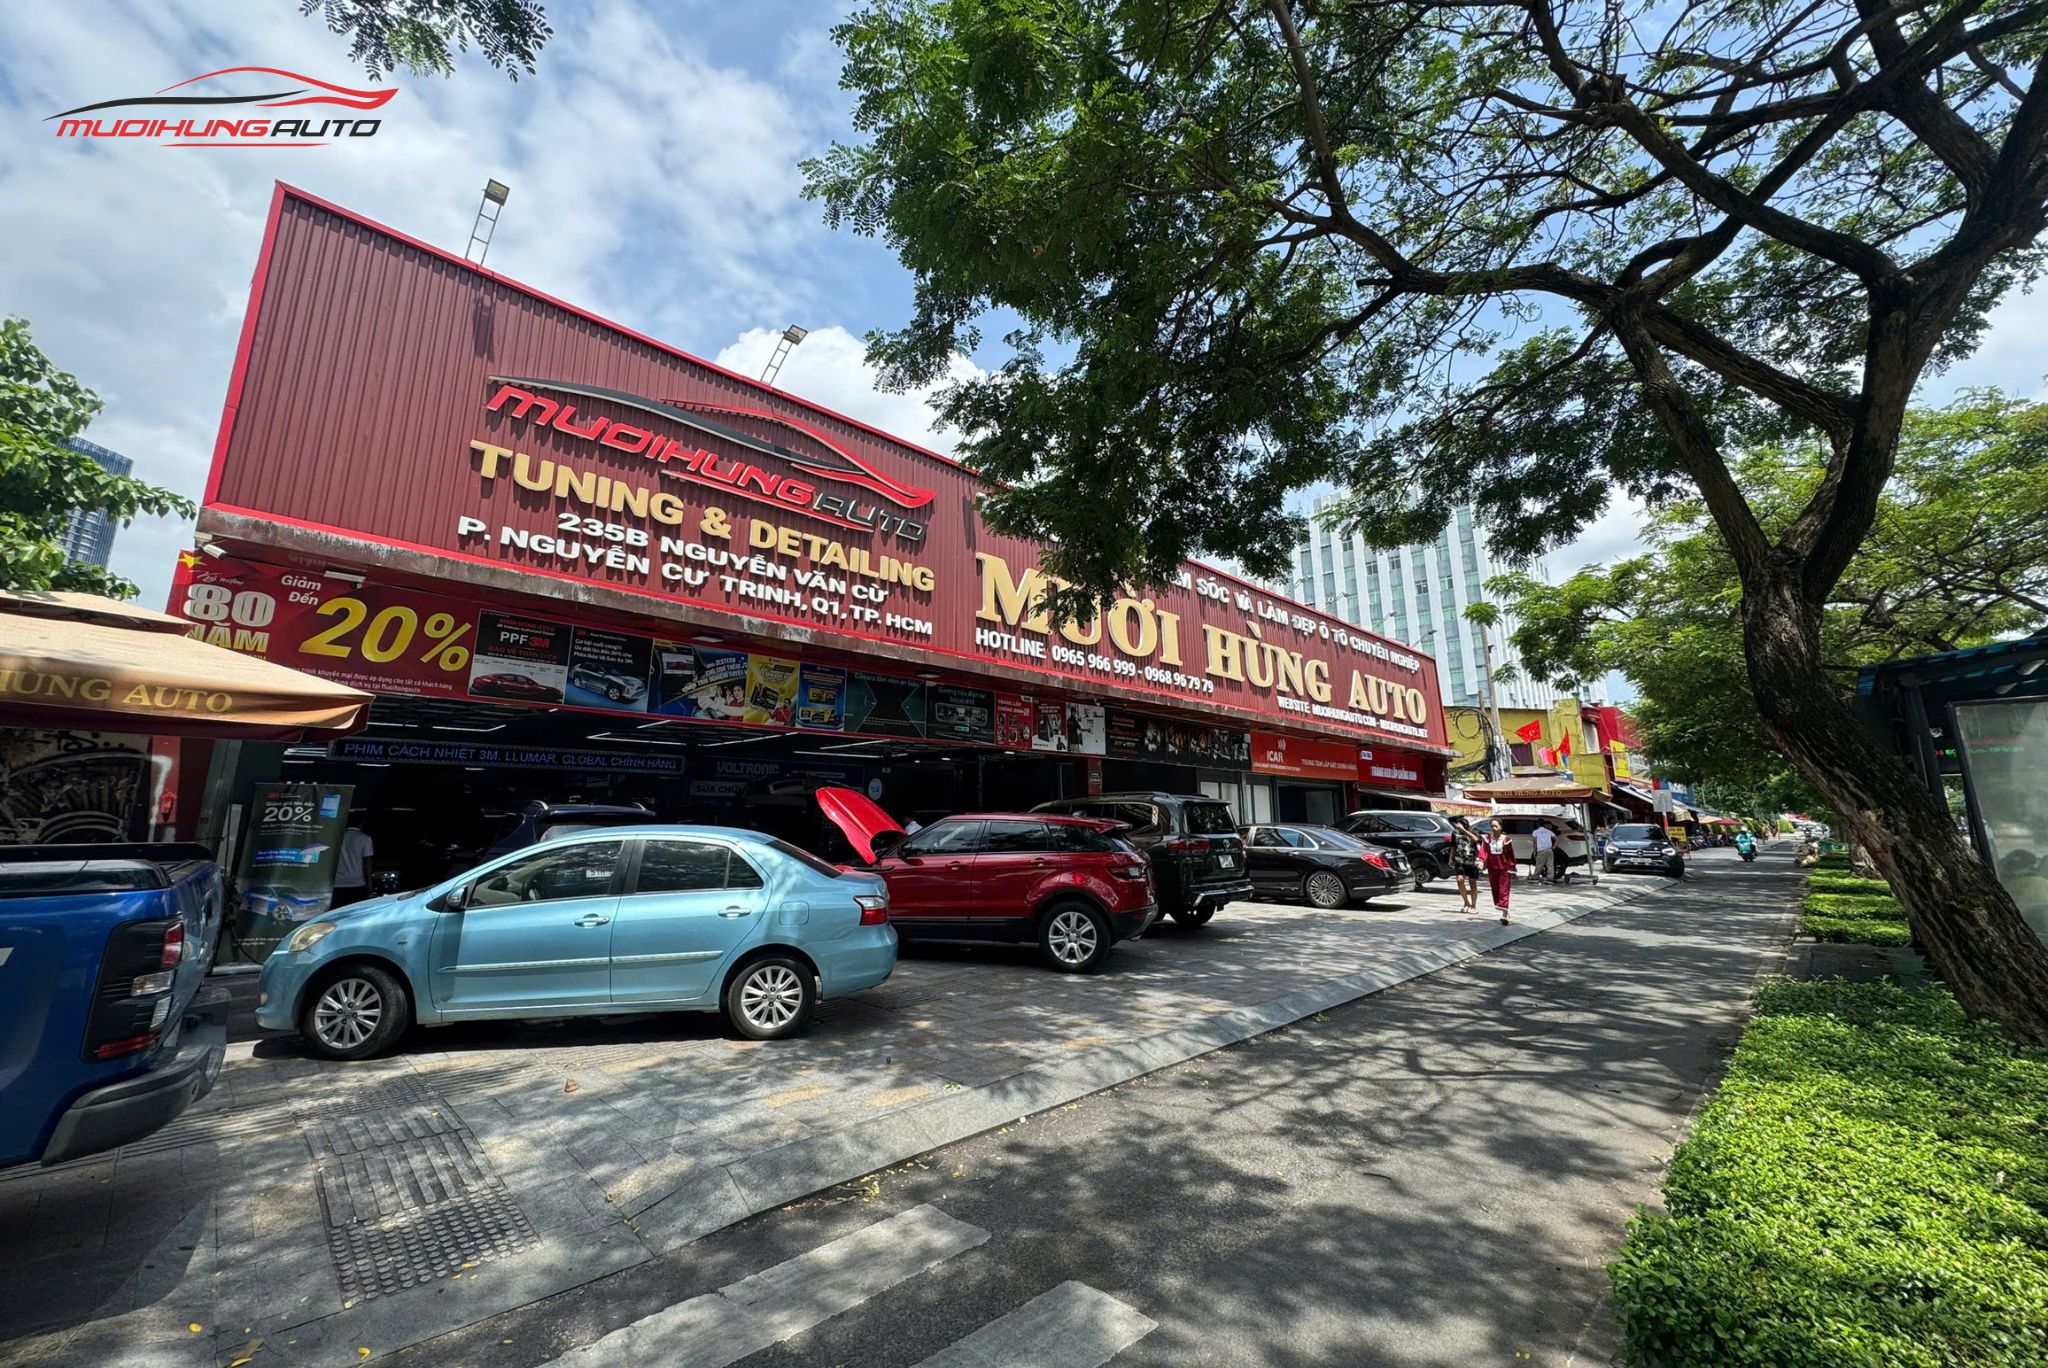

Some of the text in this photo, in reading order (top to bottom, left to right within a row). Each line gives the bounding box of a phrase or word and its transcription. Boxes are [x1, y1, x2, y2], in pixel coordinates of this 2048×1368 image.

[470, 439, 935, 591] TUNING & DETAILING
[458, 515, 491, 540] P.
[500, 526, 649, 574] NGUYỄN
[662, 563, 710, 586] CƯ
[720, 575, 808, 610] TRINH,
[850, 604, 881, 624] TP.
[886, 612, 932, 635] HCM
[558, 512, 889, 602] 235B NGUYỄN VĂN CỪ
[281, 574, 321, 591] Giảm
[288, 591, 318, 606] Đến
[183, 583, 276, 627] 80
[1196, 577, 1229, 603] SÓC
[1234, 590, 1254, 613] VÀ
[1257, 600, 1288, 626] LÀM
[1291, 614, 1317, 636] ĐẸP
[1318, 621, 1329, 639] Ô
[1331, 628, 1348, 646] TÔ
[1349, 636, 1389, 661] CHUYÊN
[298, 597, 472, 672] 20%
[500, 631, 550, 649] PPF 3M
[976, 627, 1047, 659] HOTLINE
[1052, 645, 1084, 667] 0965
[1088, 652, 1111, 672] 966
[1113, 659, 1136, 677] 999
[1144, 665, 1172, 685] 0968
[1203, 620, 1332, 702] HÙNG
[1348, 669, 1427, 725] AUTO
[122, 683, 234, 712] AUTO
[1277, 696, 1310, 714] WEBSITE
[344, 743, 384, 755] PHIM
[562, 754, 609, 766] GLOBAL
[1266, 749, 1284, 763] ICAR
[263, 806, 314, 822] 20%
